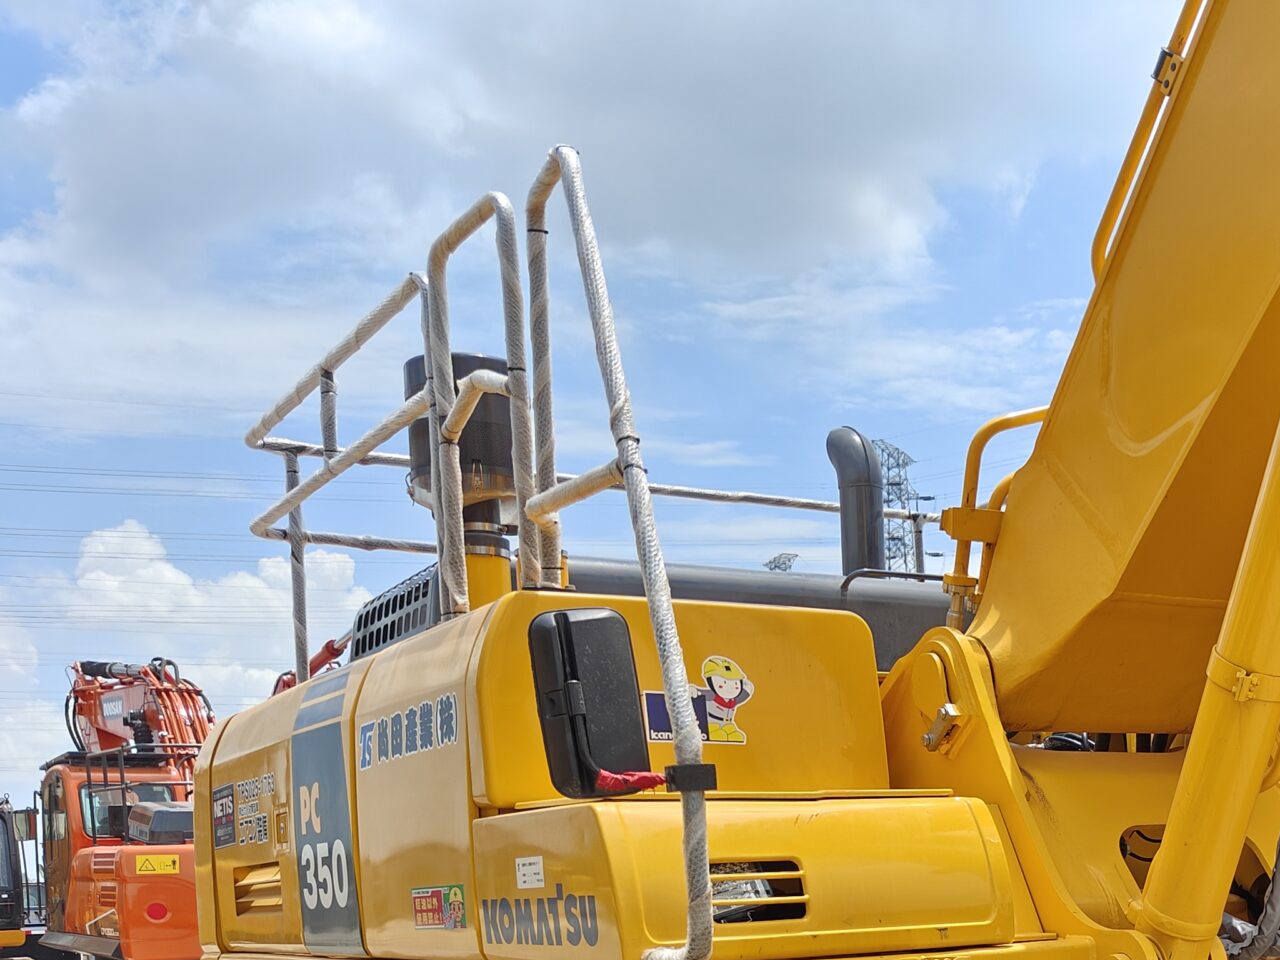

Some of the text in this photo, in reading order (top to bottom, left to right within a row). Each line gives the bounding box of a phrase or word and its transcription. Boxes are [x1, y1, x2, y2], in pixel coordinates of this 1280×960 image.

[213, 796, 234, 818] NETIS
[299, 782, 321, 835] PC
[301, 838, 349, 910] 350
[482, 883, 599, 947] KOMATSU
